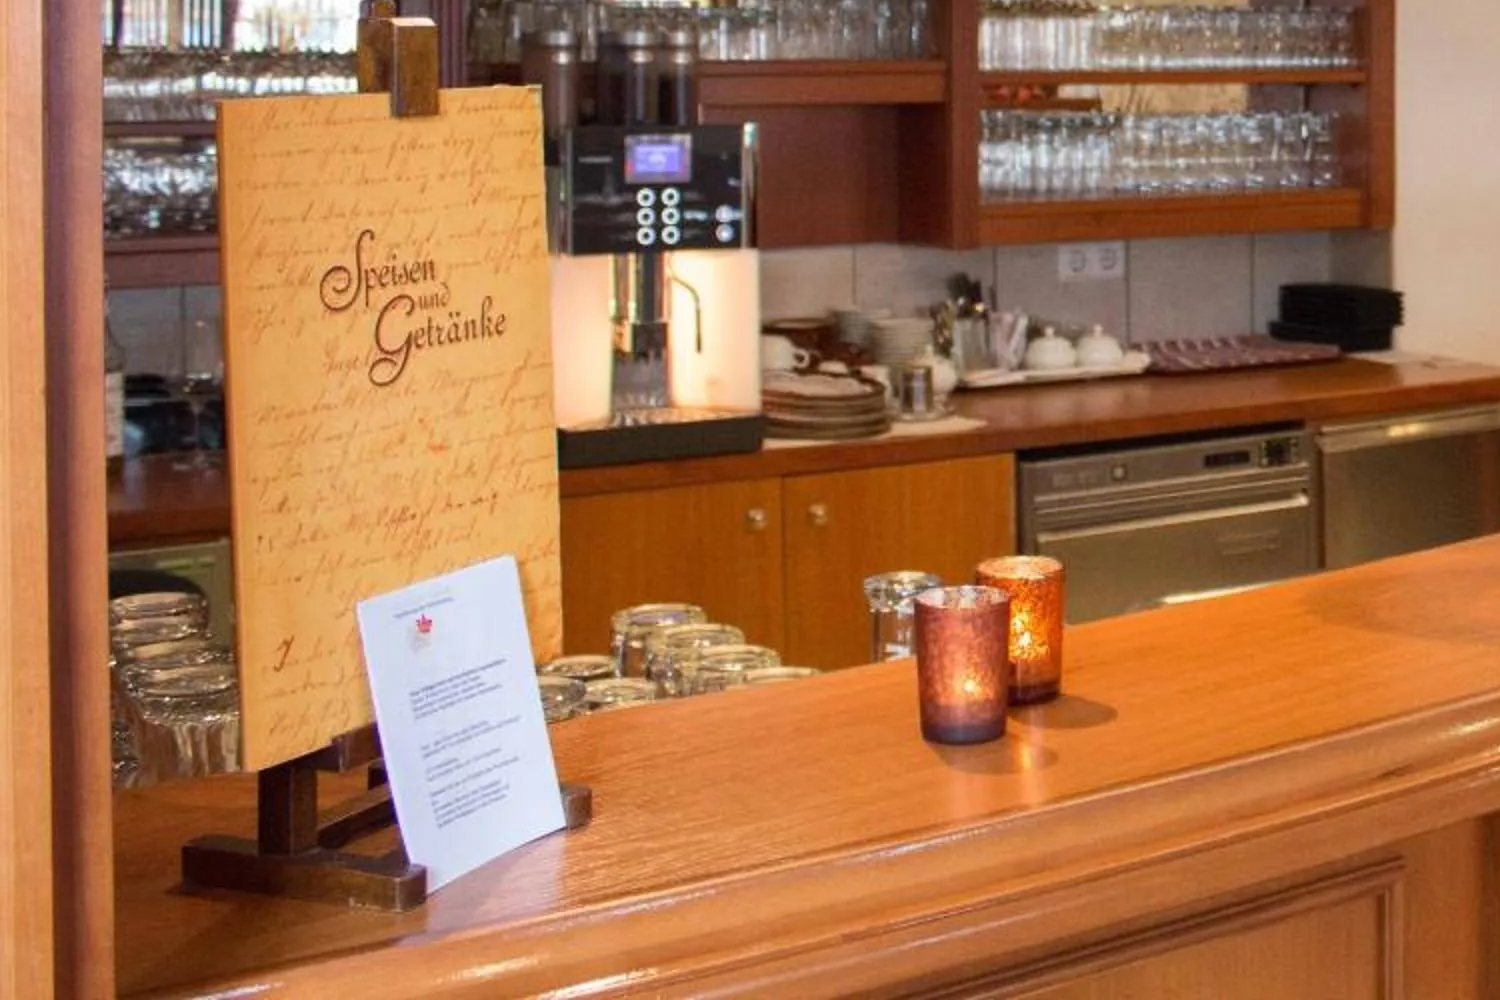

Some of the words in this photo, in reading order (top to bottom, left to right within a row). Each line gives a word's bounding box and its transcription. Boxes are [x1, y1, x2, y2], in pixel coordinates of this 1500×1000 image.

[319, 229, 436, 312] Speisen
[418, 281, 450, 311] und
[367, 294, 506, 387] Getränke
